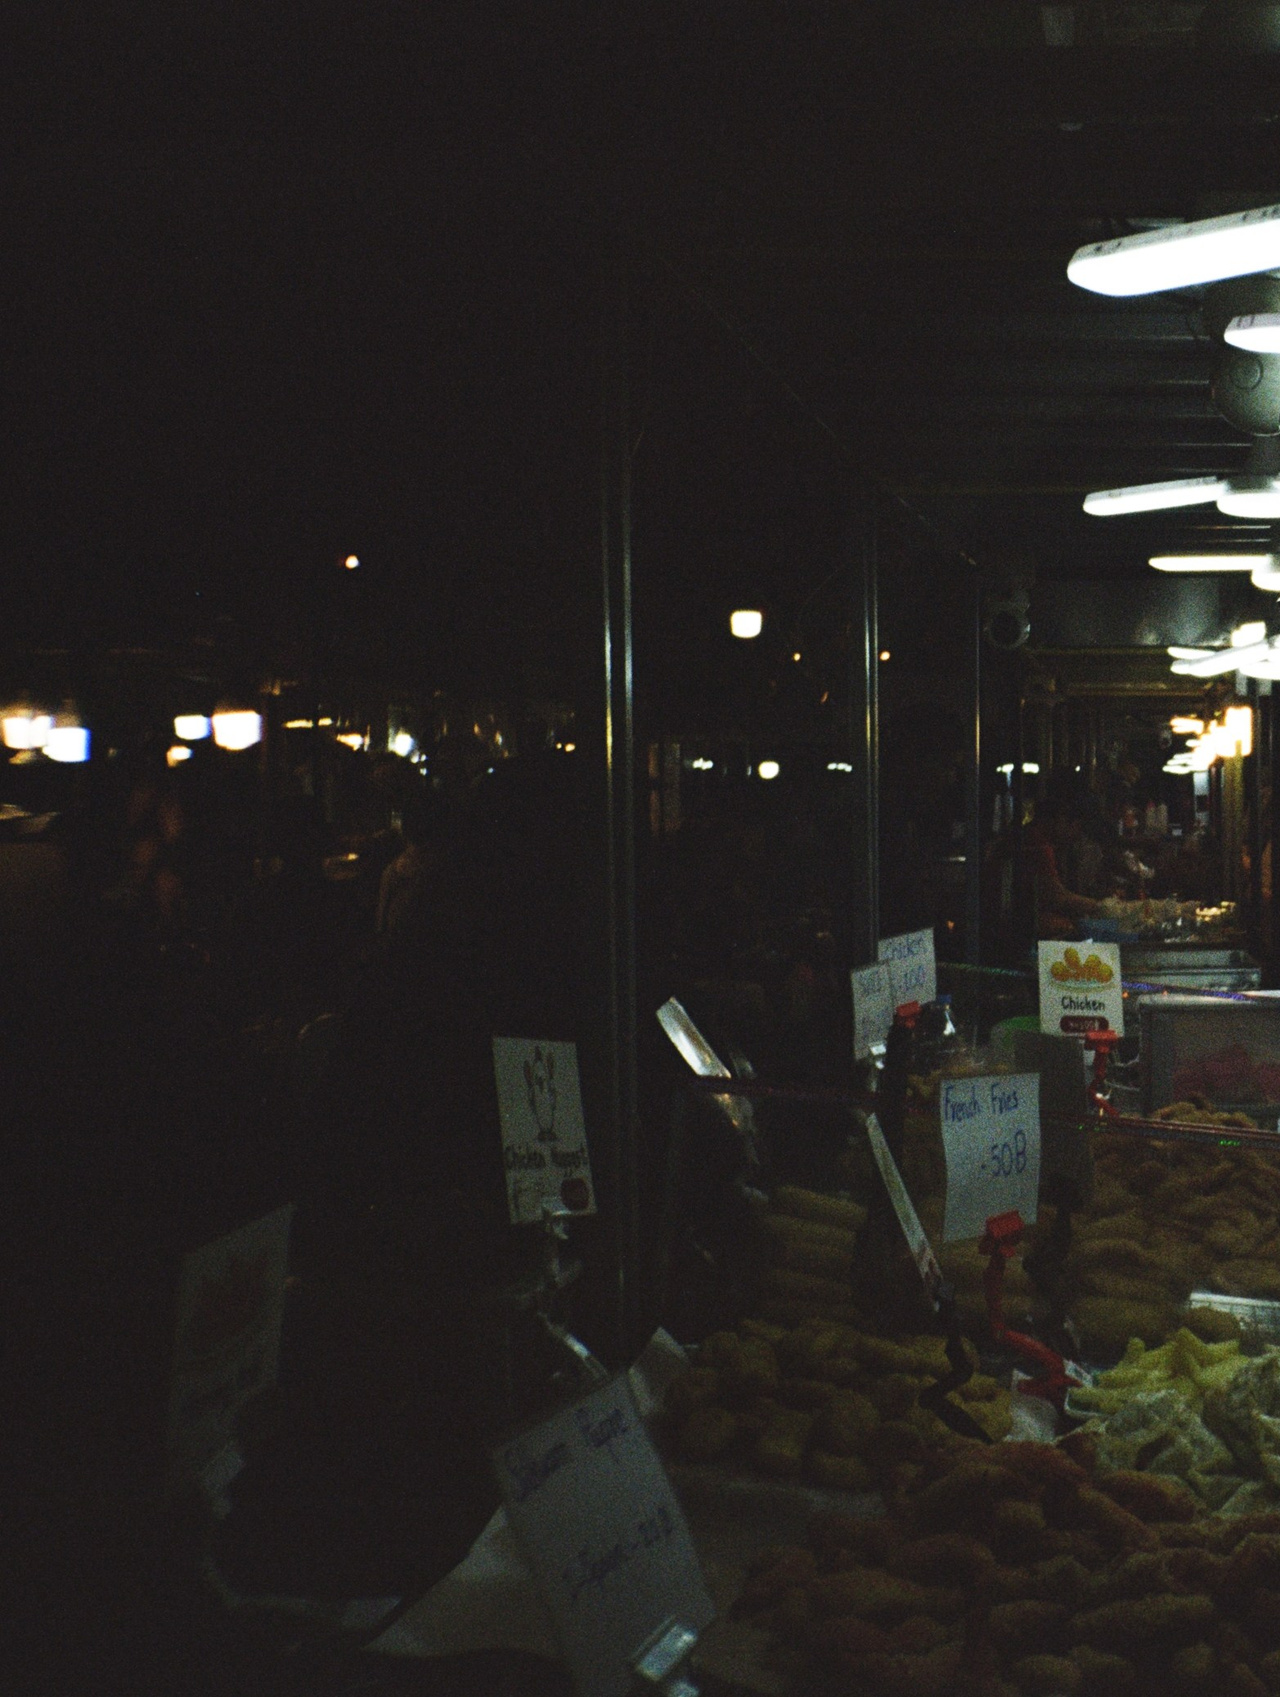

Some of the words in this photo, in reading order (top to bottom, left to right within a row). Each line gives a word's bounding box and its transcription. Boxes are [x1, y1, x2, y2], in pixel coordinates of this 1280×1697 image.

[1061, 996, 1106, 1011] Chicken
[945, 1085, 981, 1122] French
[991, 1082, 1019, 1115] Fries
